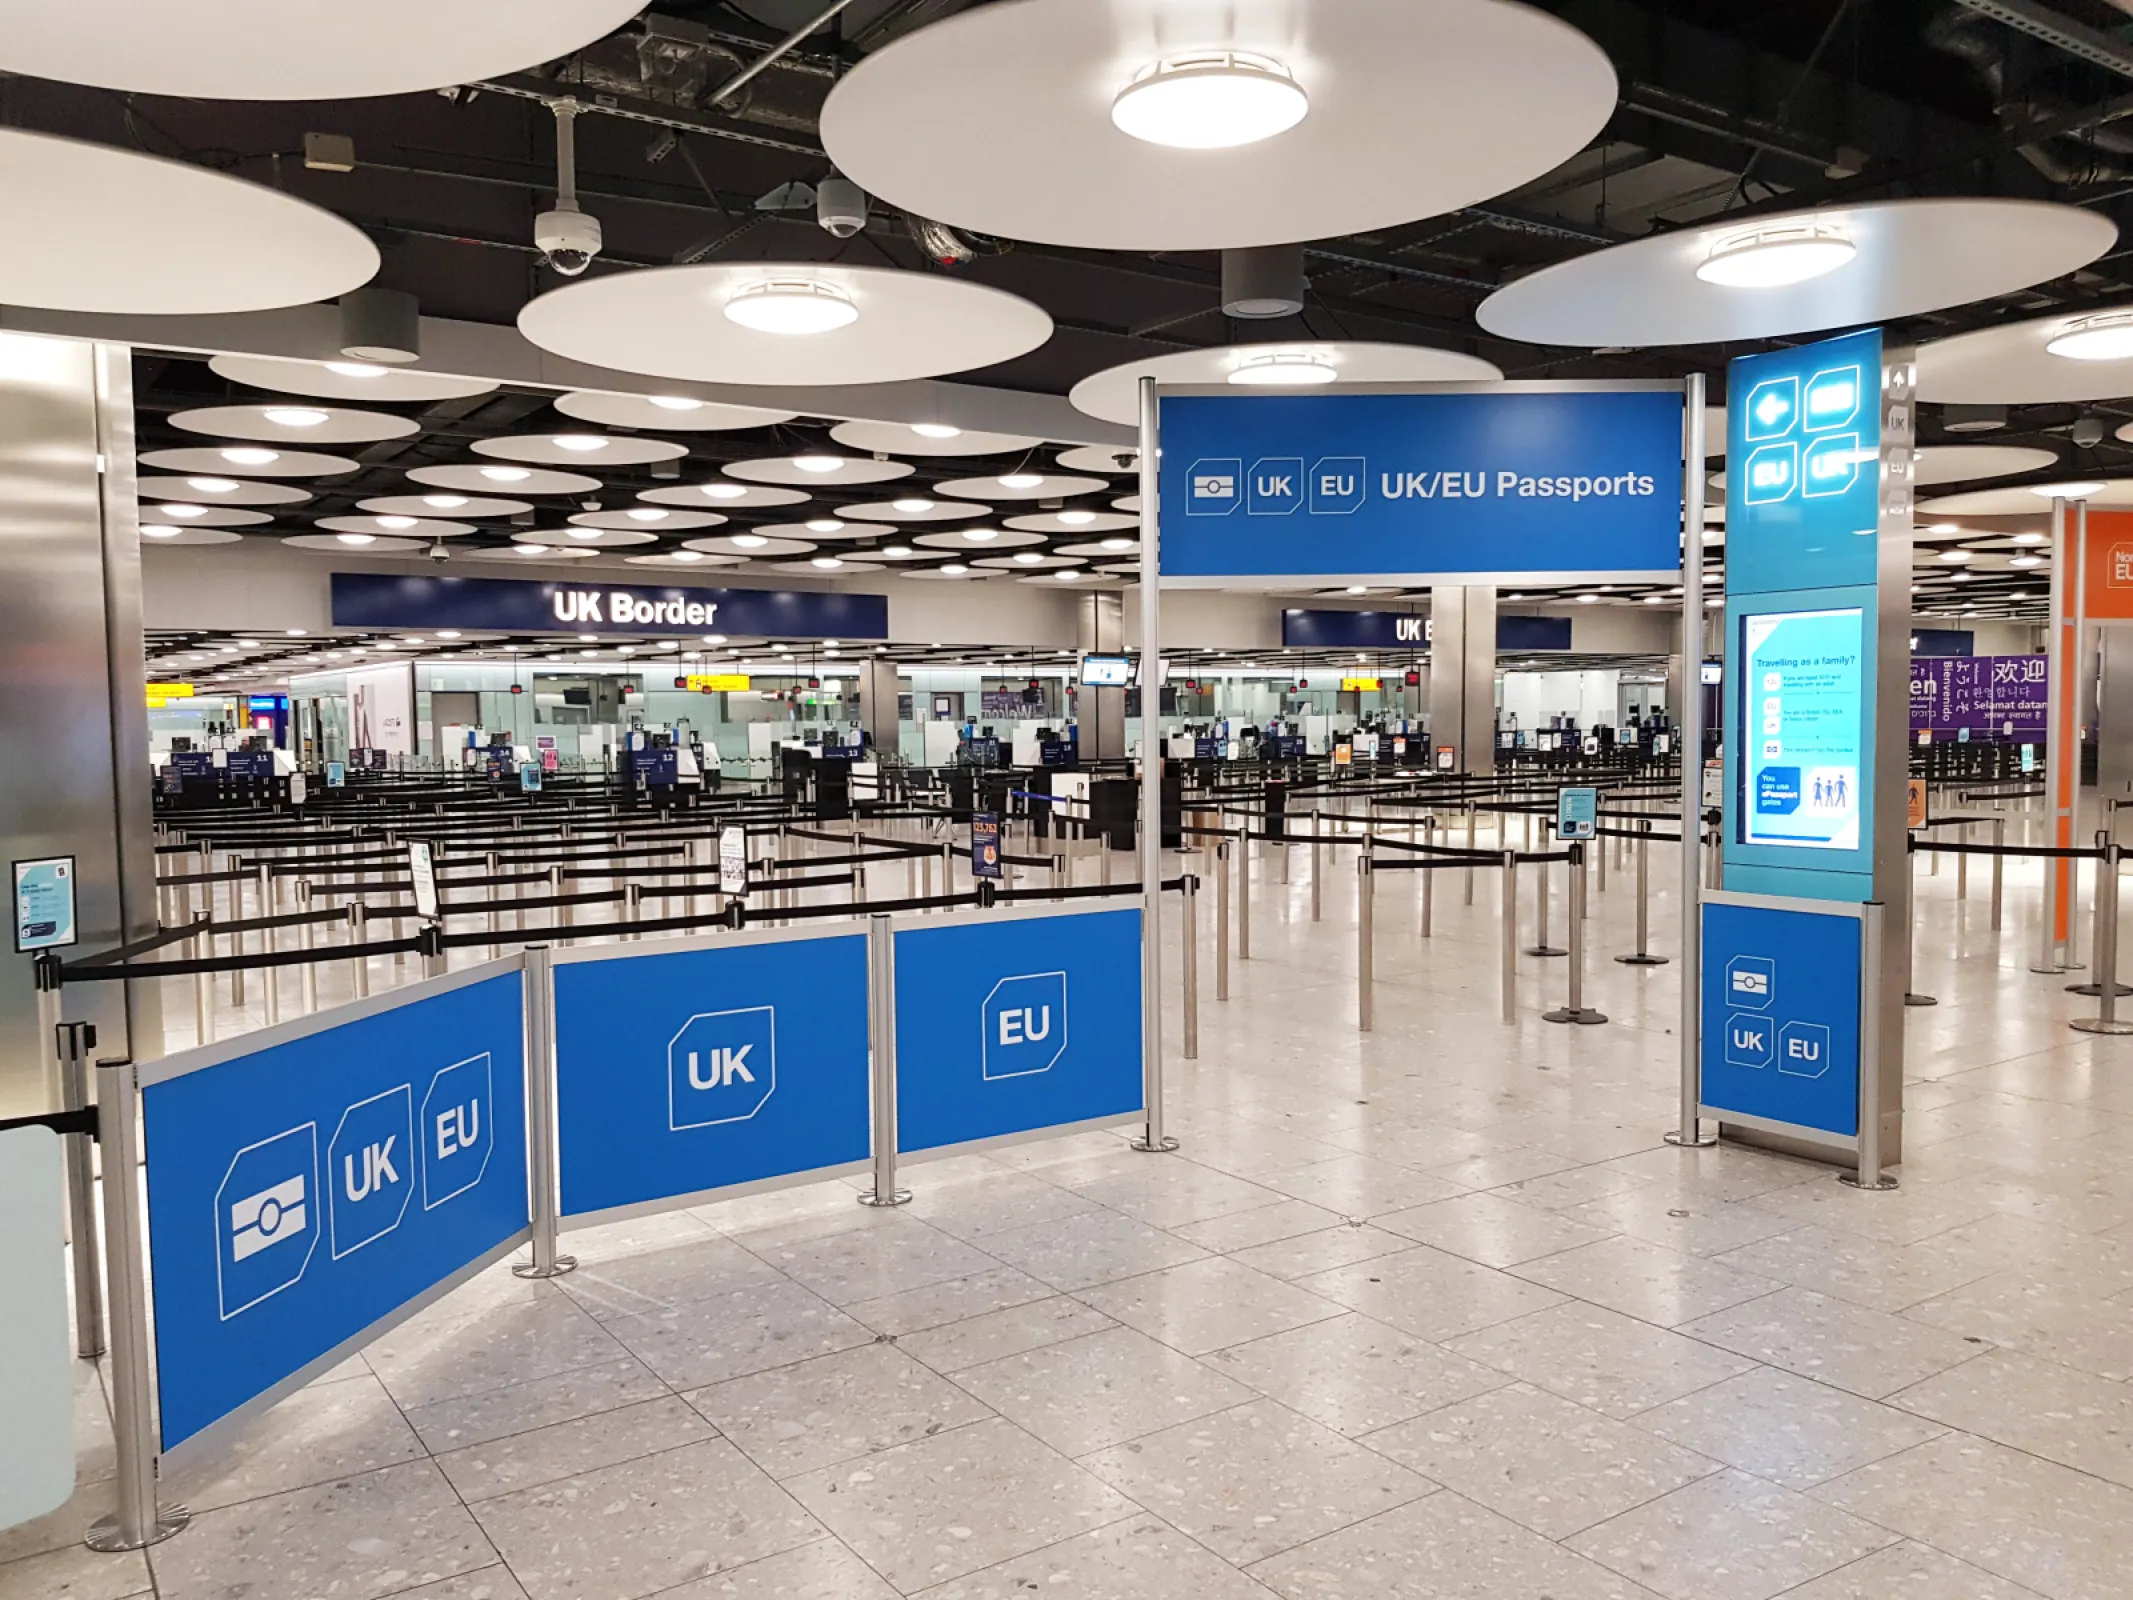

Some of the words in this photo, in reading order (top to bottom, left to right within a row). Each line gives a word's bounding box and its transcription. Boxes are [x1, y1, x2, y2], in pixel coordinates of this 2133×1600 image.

[1891, 416, 1905, 430] UK
[1754, 460, 1788, 486] EU
[1258, 476, 1292, 497] UK
[1321, 475, 1354, 496] EU
[1381, 471, 1486, 499] UK/EU
[1497, 471, 1654, 502] Passports
[554, 591, 603, 622] UK
[610, 592, 718, 625] Border
[1396, 619, 1421, 641] UK
[1757, 658, 1798, 669] Travelling
[1800, 658, 1812, 667] as
[1814, 658, 1820, 666] a
[1822, 655, 1856, 667] family?
[1993, 659, 2047, 684] 欢迎
[1942, 660, 1953, 722] Bienvenido
[1955, 660, 1970, 715] ようこそ
[1973, 699, 2016, 710] Selamat
[257, 754, 269, 762] 11
[663, 754, 674, 762] 12
[1761, 774, 1776, 782] You
[1761, 799, 1782, 807] gates
[999, 1005, 1050, 1045] EU
[1734, 1029, 1764, 1052] UK
[1788, 1038, 1819, 1061] EU
[688, 1044, 755, 1090] UK
[437, 1098, 478, 1159] EU
[345, 1135, 399, 1202] UK
